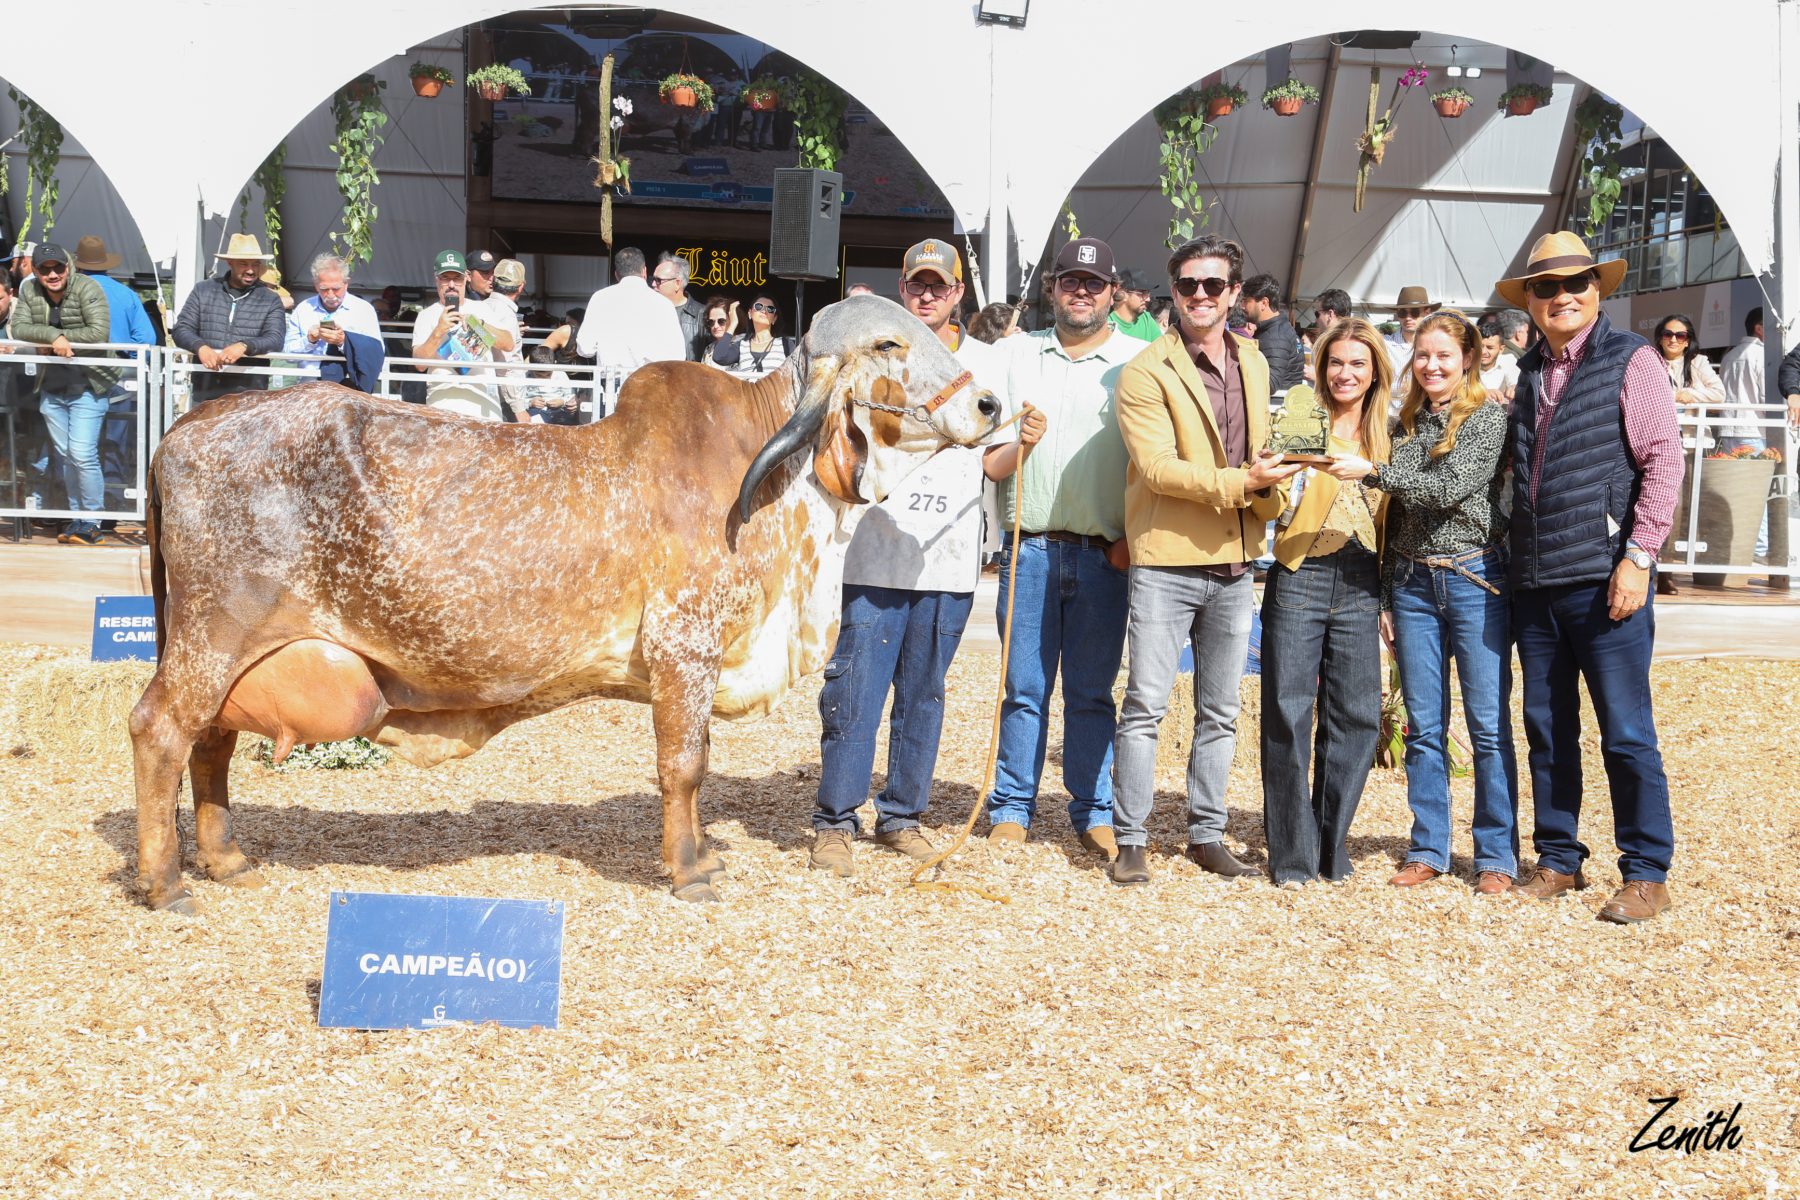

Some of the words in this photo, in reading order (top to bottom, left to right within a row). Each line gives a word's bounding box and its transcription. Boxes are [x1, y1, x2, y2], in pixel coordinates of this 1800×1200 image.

[675, 247, 767, 287] Läut
[908, 492, 947, 513] 275
[359, 952, 527, 983] CAMPEÃ(O)
